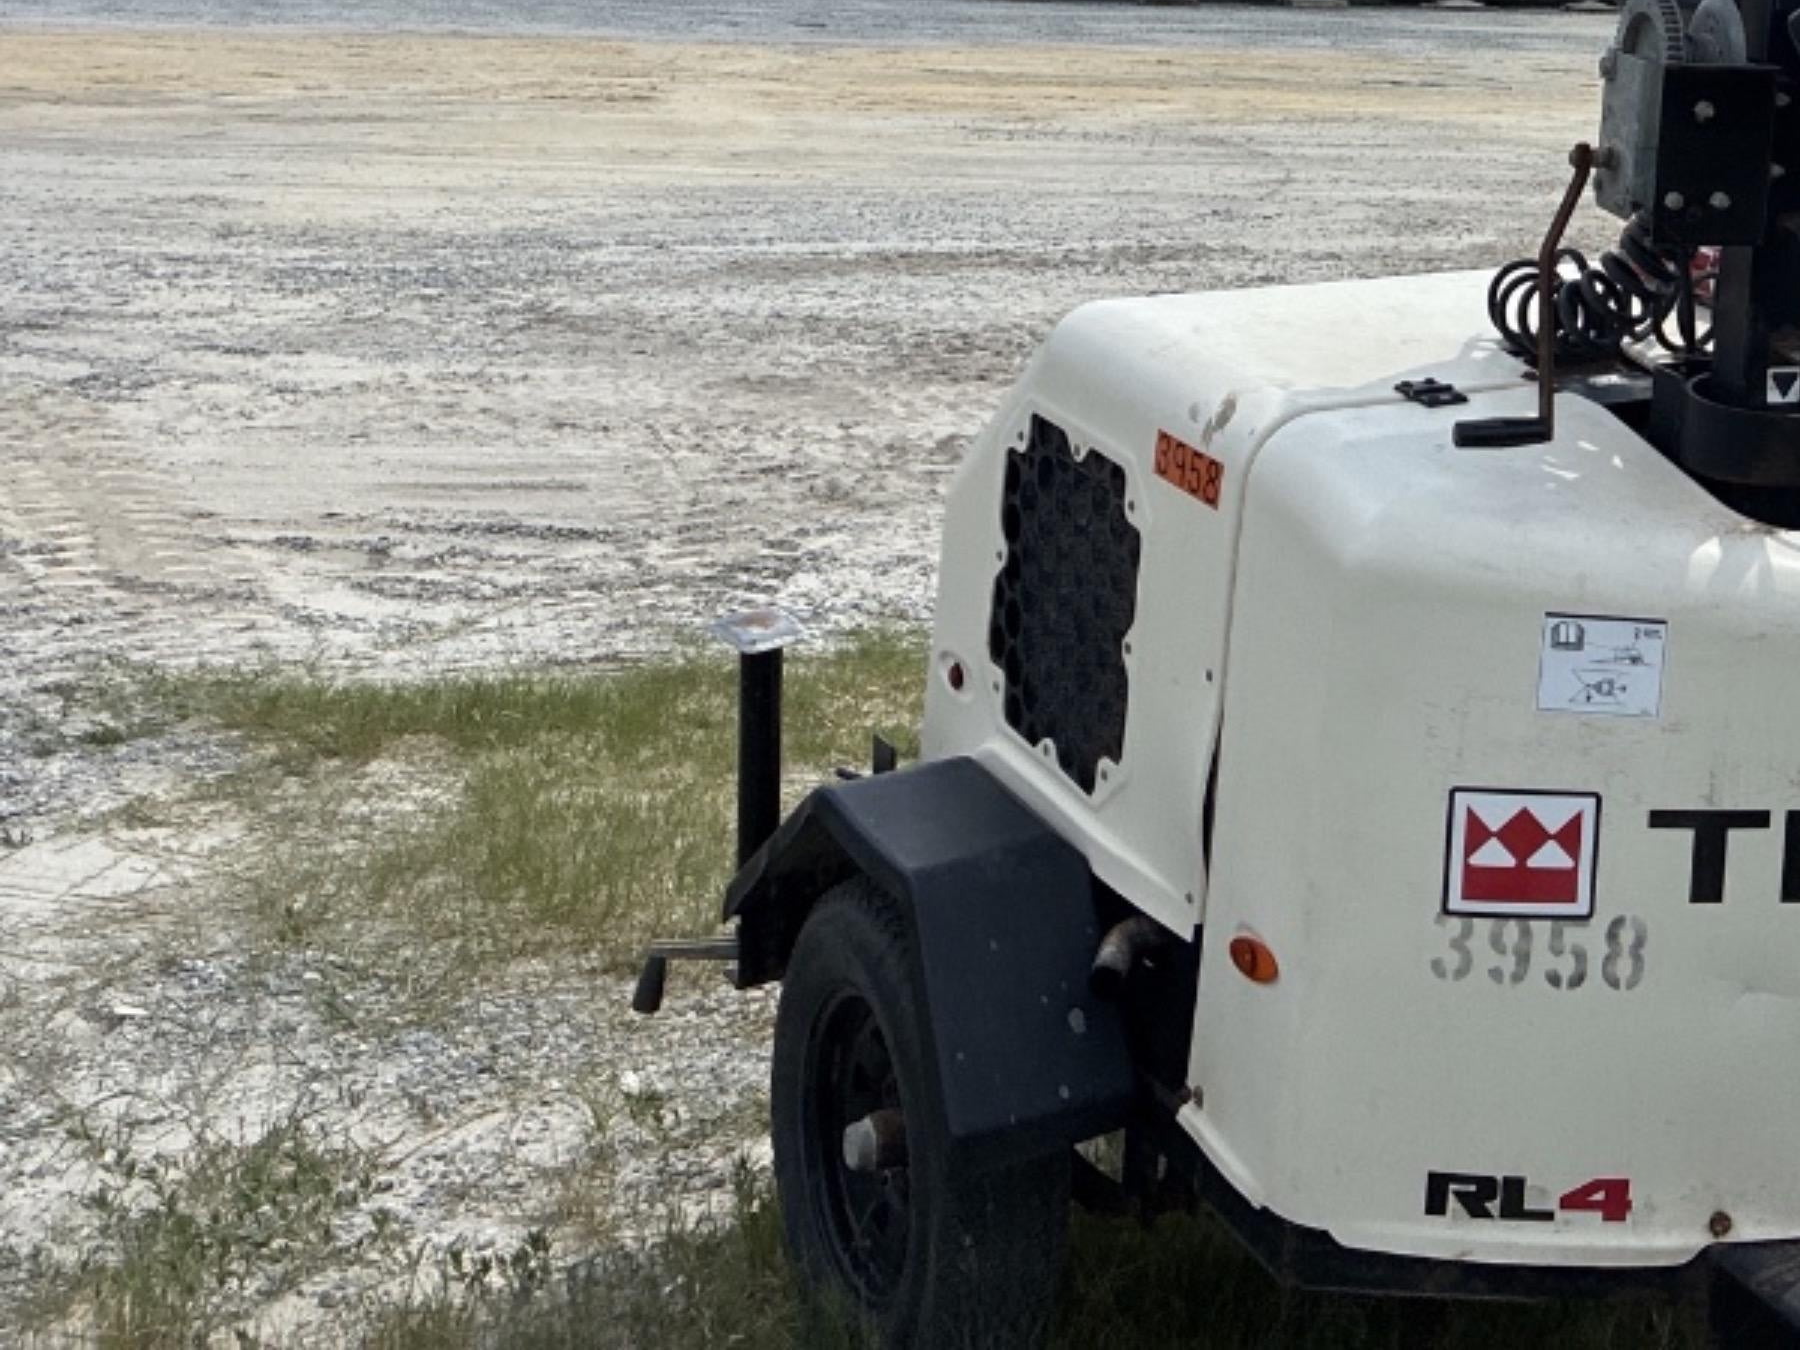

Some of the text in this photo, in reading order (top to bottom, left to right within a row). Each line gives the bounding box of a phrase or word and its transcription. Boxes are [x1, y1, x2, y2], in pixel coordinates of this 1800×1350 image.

[1156, 430, 1219, 508] 3958
[1430, 914, 1648, 991] 3958
[1424, 1170, 1632, 1222] RL4
